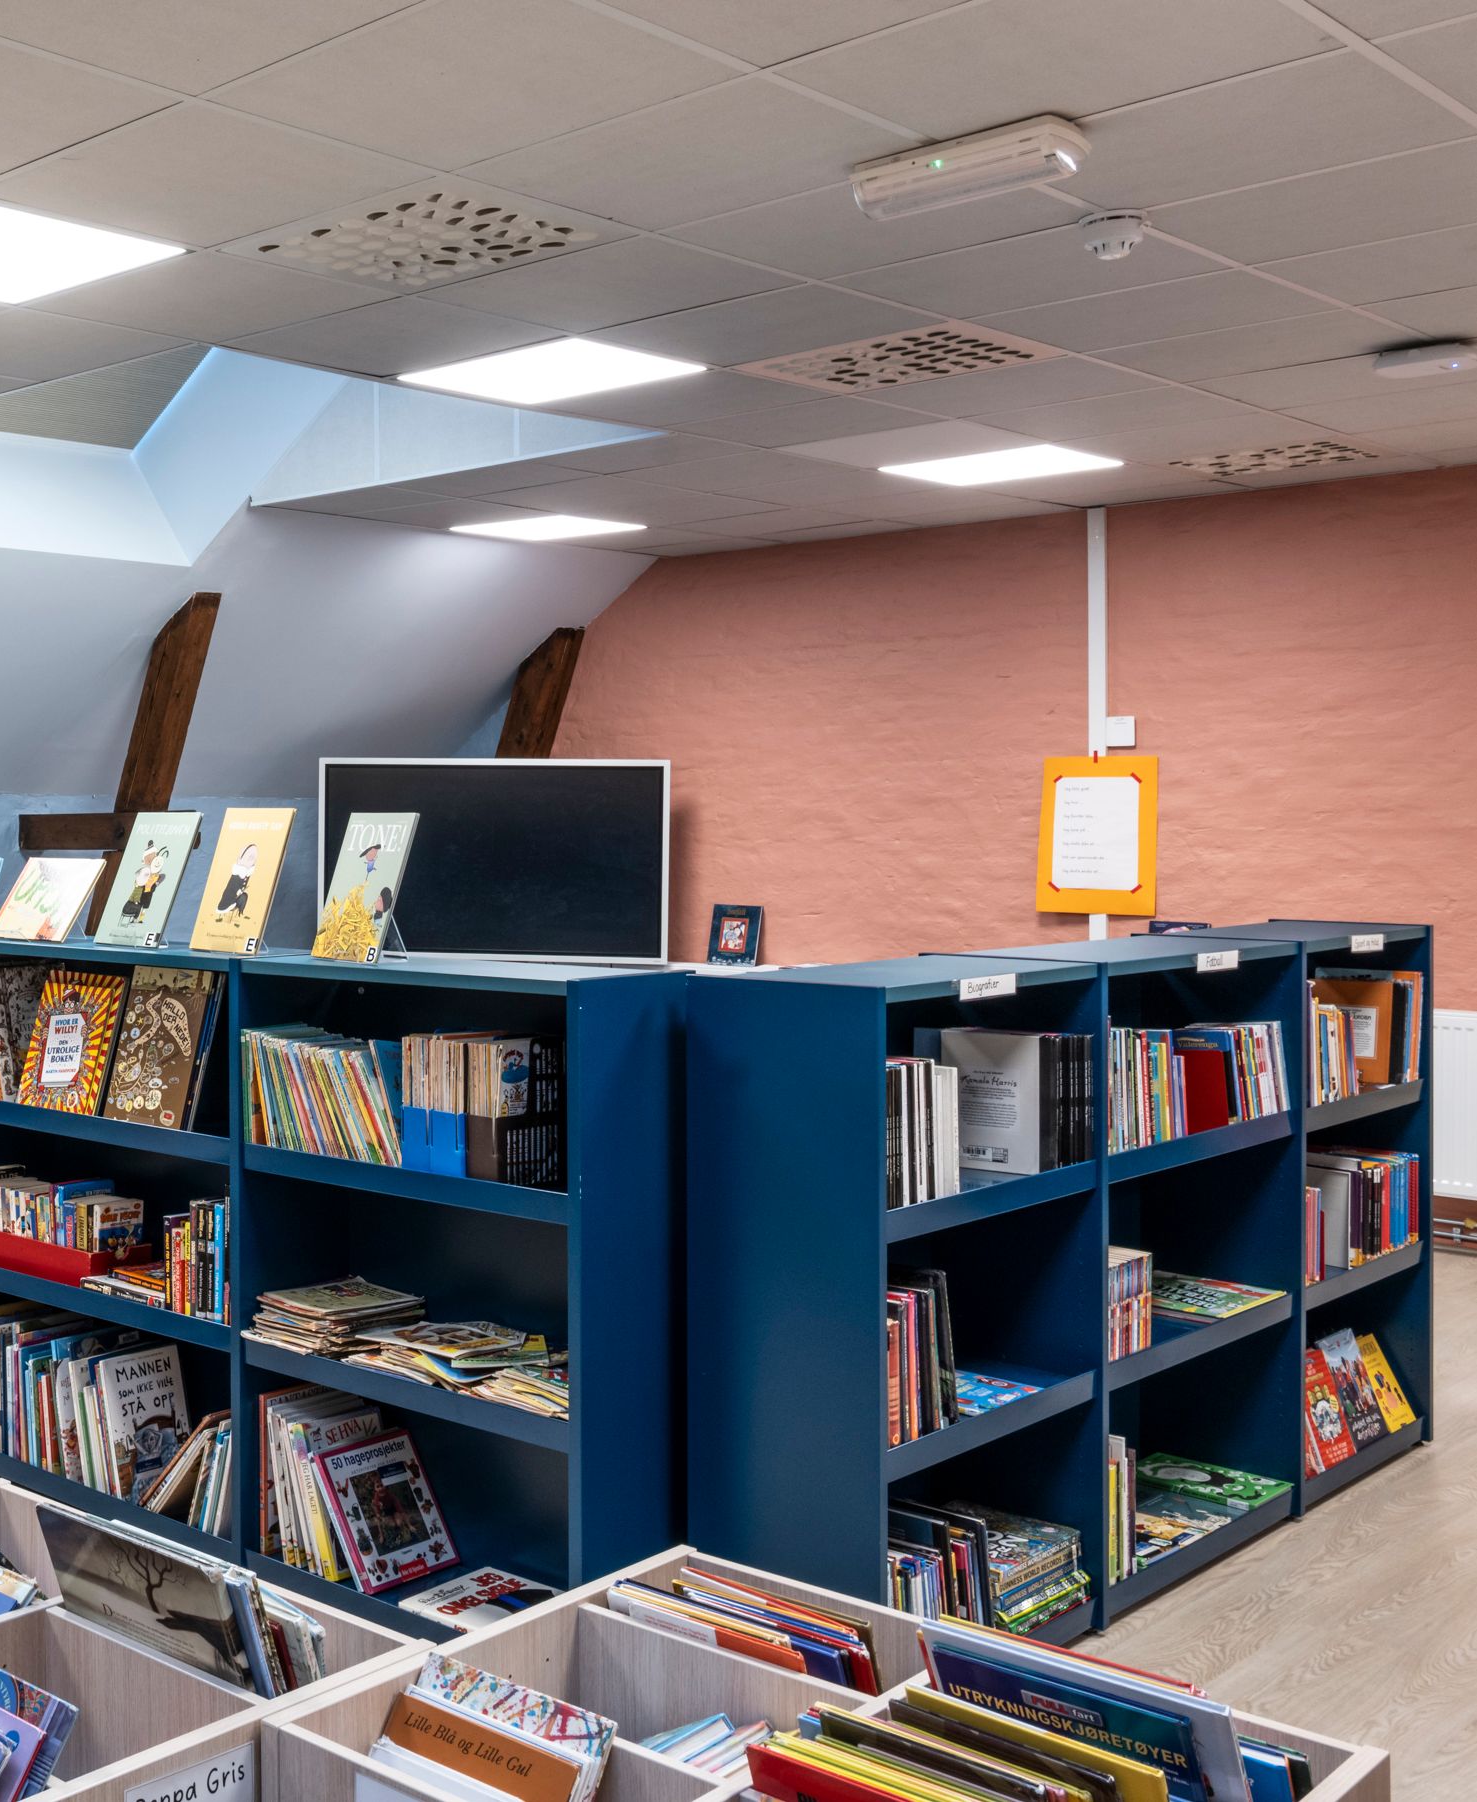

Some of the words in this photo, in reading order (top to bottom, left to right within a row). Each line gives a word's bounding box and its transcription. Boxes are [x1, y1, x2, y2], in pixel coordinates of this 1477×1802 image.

[348, 824, 407, 852] TONE!
[145, 933, 154, 946] E
[246, 938, 255, 951] E
[366, 948, 375, 961] B
[967, 980, 1000, 996] Biografier
[163, 1000, 186, 1020] HALLO
[163, 1013, 177, 1024] DER
[47, 1045, 80, 1055] UTROLIGE
[51, 1055, 74, 1063] BOKEN
[991, 1075, 1018, 1088] Harris
[115, 1356, 171, 1383] MANNEN
[118, 1388, 135, 1400] SOM
[136, 1382, 154, 1394] IKKE
[157, 1377, 175, 1389] VILLE
[121, 1398, 147, 1417] STÅ
[153, 1392, 175, 1409] OPP
[325, 1428, 339, 1446] SE
[341, 1418, 362, 1441] HVA
[331, 1459, 343, 1470] 50
[343, 1439, 407, 1467] hageprosjekter
[470, 1572, 505, 1587] JEG
[436, 1595, 485, 1616] ONKEL
[948, 1682, 1188, 1769] UTRYKNINGSKJØRETØYER
[1071, 1708, 1096, 1723] fart
[404, 1712, 430, 1735] Lille
[432, 1723, 457, 1746] Blå
[458, 1737, 474, 1756] og
[474, 1739, 504, 1765] Lille
[507, 1754, 533, 1778] Gul
[207, 1763, 245, 1794] Gris
